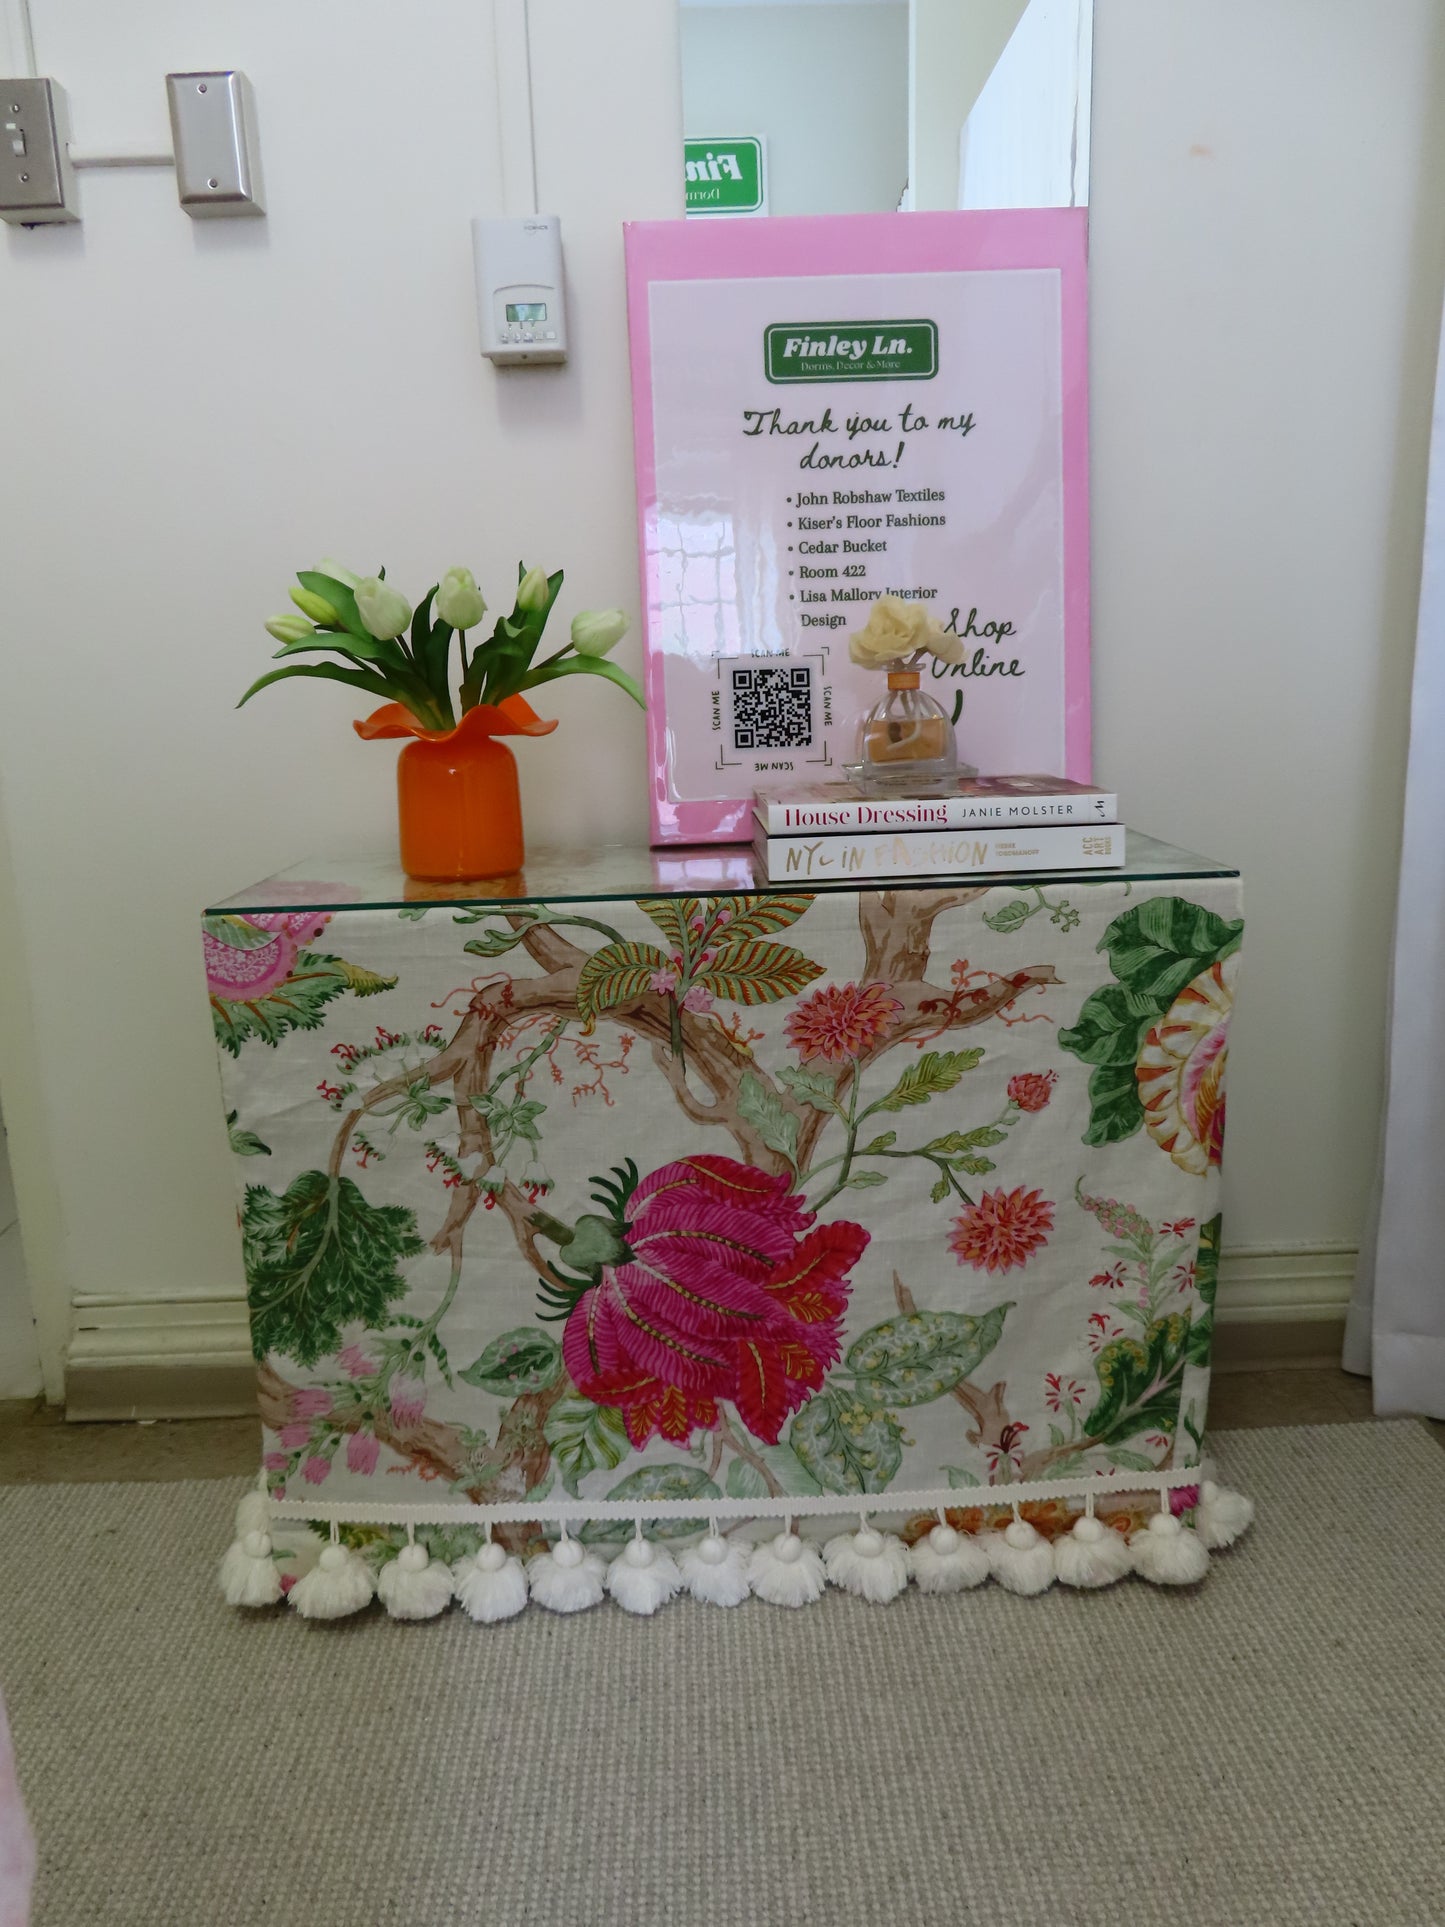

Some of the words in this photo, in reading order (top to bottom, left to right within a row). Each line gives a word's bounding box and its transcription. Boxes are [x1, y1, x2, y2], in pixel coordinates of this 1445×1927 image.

[783, 335, 867, 361] Finley
[871, 335, 913, 355] Ln.
[836, 361, 864, 370] Decor
[866, 361, 876, 369] &
[876, 360, 901, 369] More
[743, 408, 839, 436] Thank
[846, 411, 892, 440] you
[898, 403, 929, 433] to
[937, 412, 977, 437] my
[800, 441, 905, 469] donors!
[795, 492, 828, 508] John
[833, 491, 892, 504] Robshaw
[896, 488, 946, 502] Textiles
[846, 515, 883, 528] Floor
[886, 513, 947, 527] Fashions
[799, 541, 839, 554] Cedar
[843, 539, 888, 553] Bucket
[799, 566, 839, 579] Room
[842, 565, 866, 577] 422
[800, 589, 827, 603] Lisa
[831, 588, 882, 602] Mallory
[886, 587, 938, 601] Interior
[801, 614, 847, 629] Design
[943, 607, 1017, 644] Shop
[711, 690, 720, 705] ME
[823, 686, 832, 709] SCAN
[712, 708, 721, 731] SCAN
[824, 711, 832, 726] ME
[755, 762, 770, 771] ME
[771, 761, 794, 771] SCAN
[785, 808, 851, 827] House
[857, 804, 948, 825] Dressing
[962, 807, 1002, 818] JANIE
[1009, 804, 1074, 816] MOLSTER
